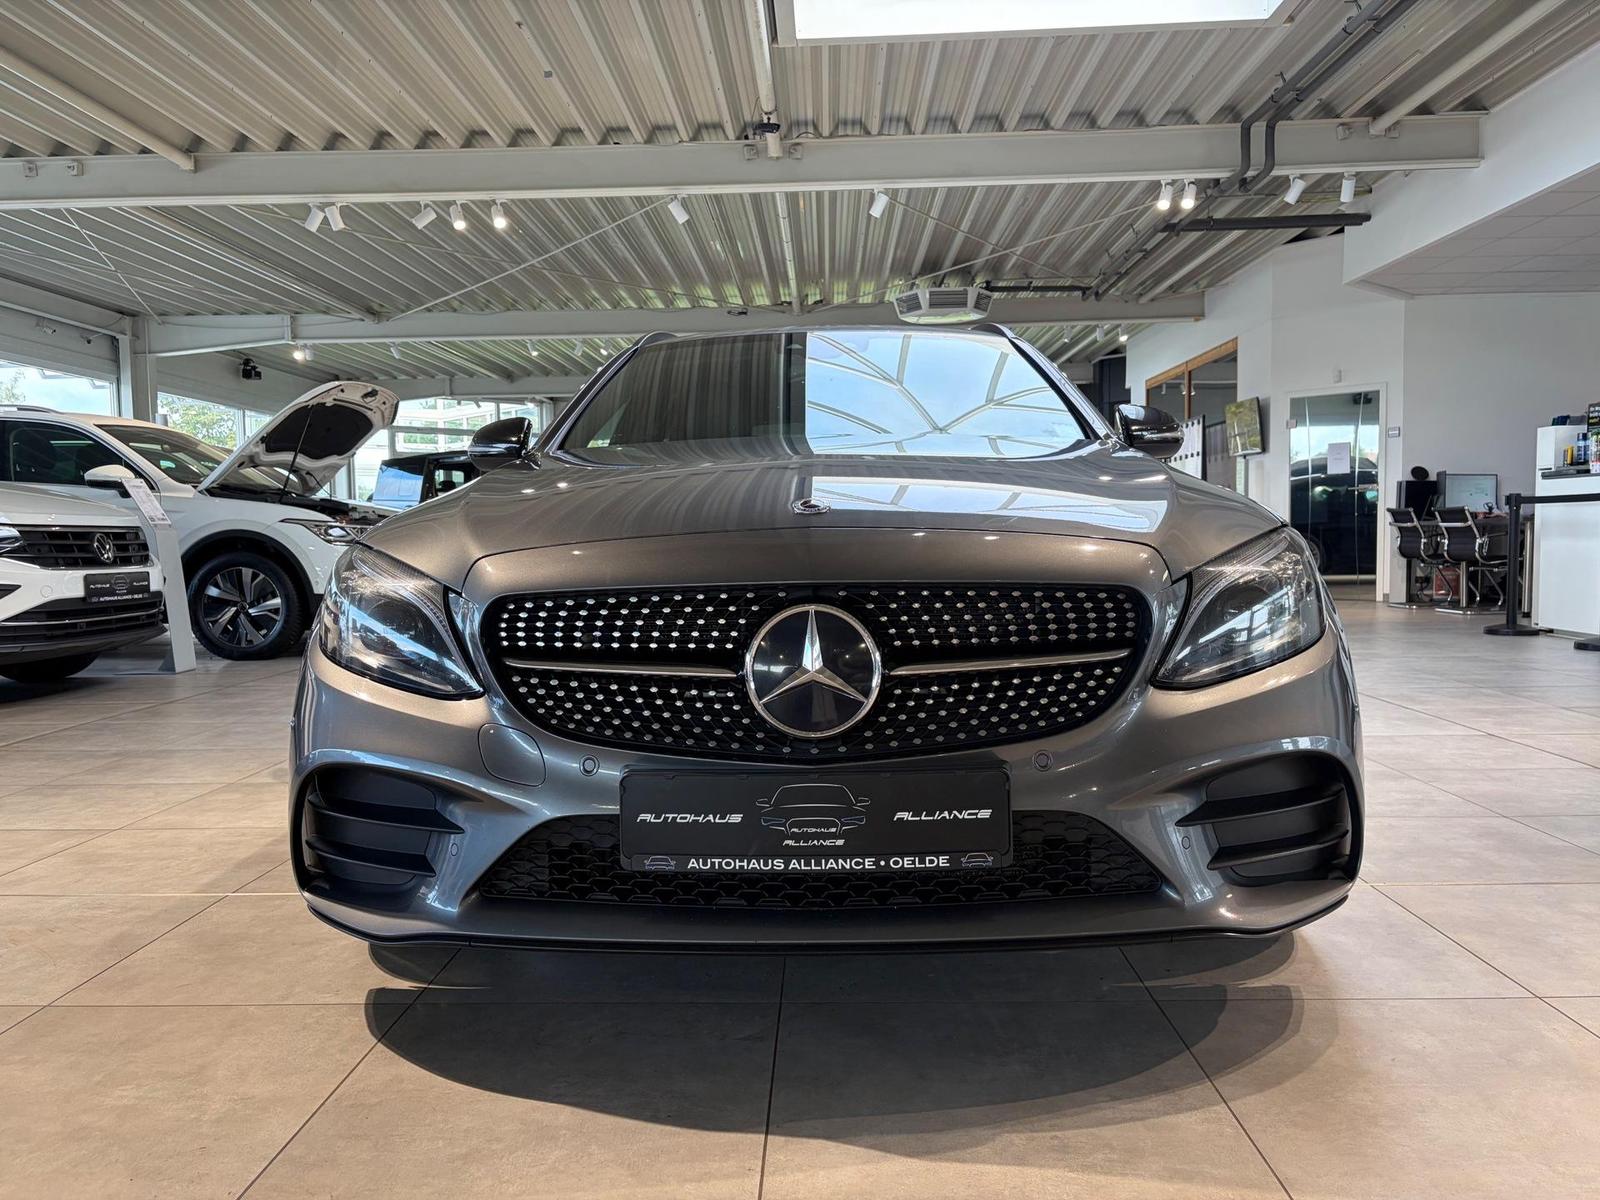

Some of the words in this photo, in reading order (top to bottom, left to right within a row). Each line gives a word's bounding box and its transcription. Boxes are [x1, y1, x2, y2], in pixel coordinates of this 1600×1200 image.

[636, 813, 744, 824] AUTOHAUS
[893, 809, 993, 821] ALLIANCE
[782, 839, 845, 847] ALLIANCE
[687, 857, 786, 871] AUTOHAUS
[788, 857, 876, 870] ALLIANCE
[889, 855, 950, 868] OELDE
